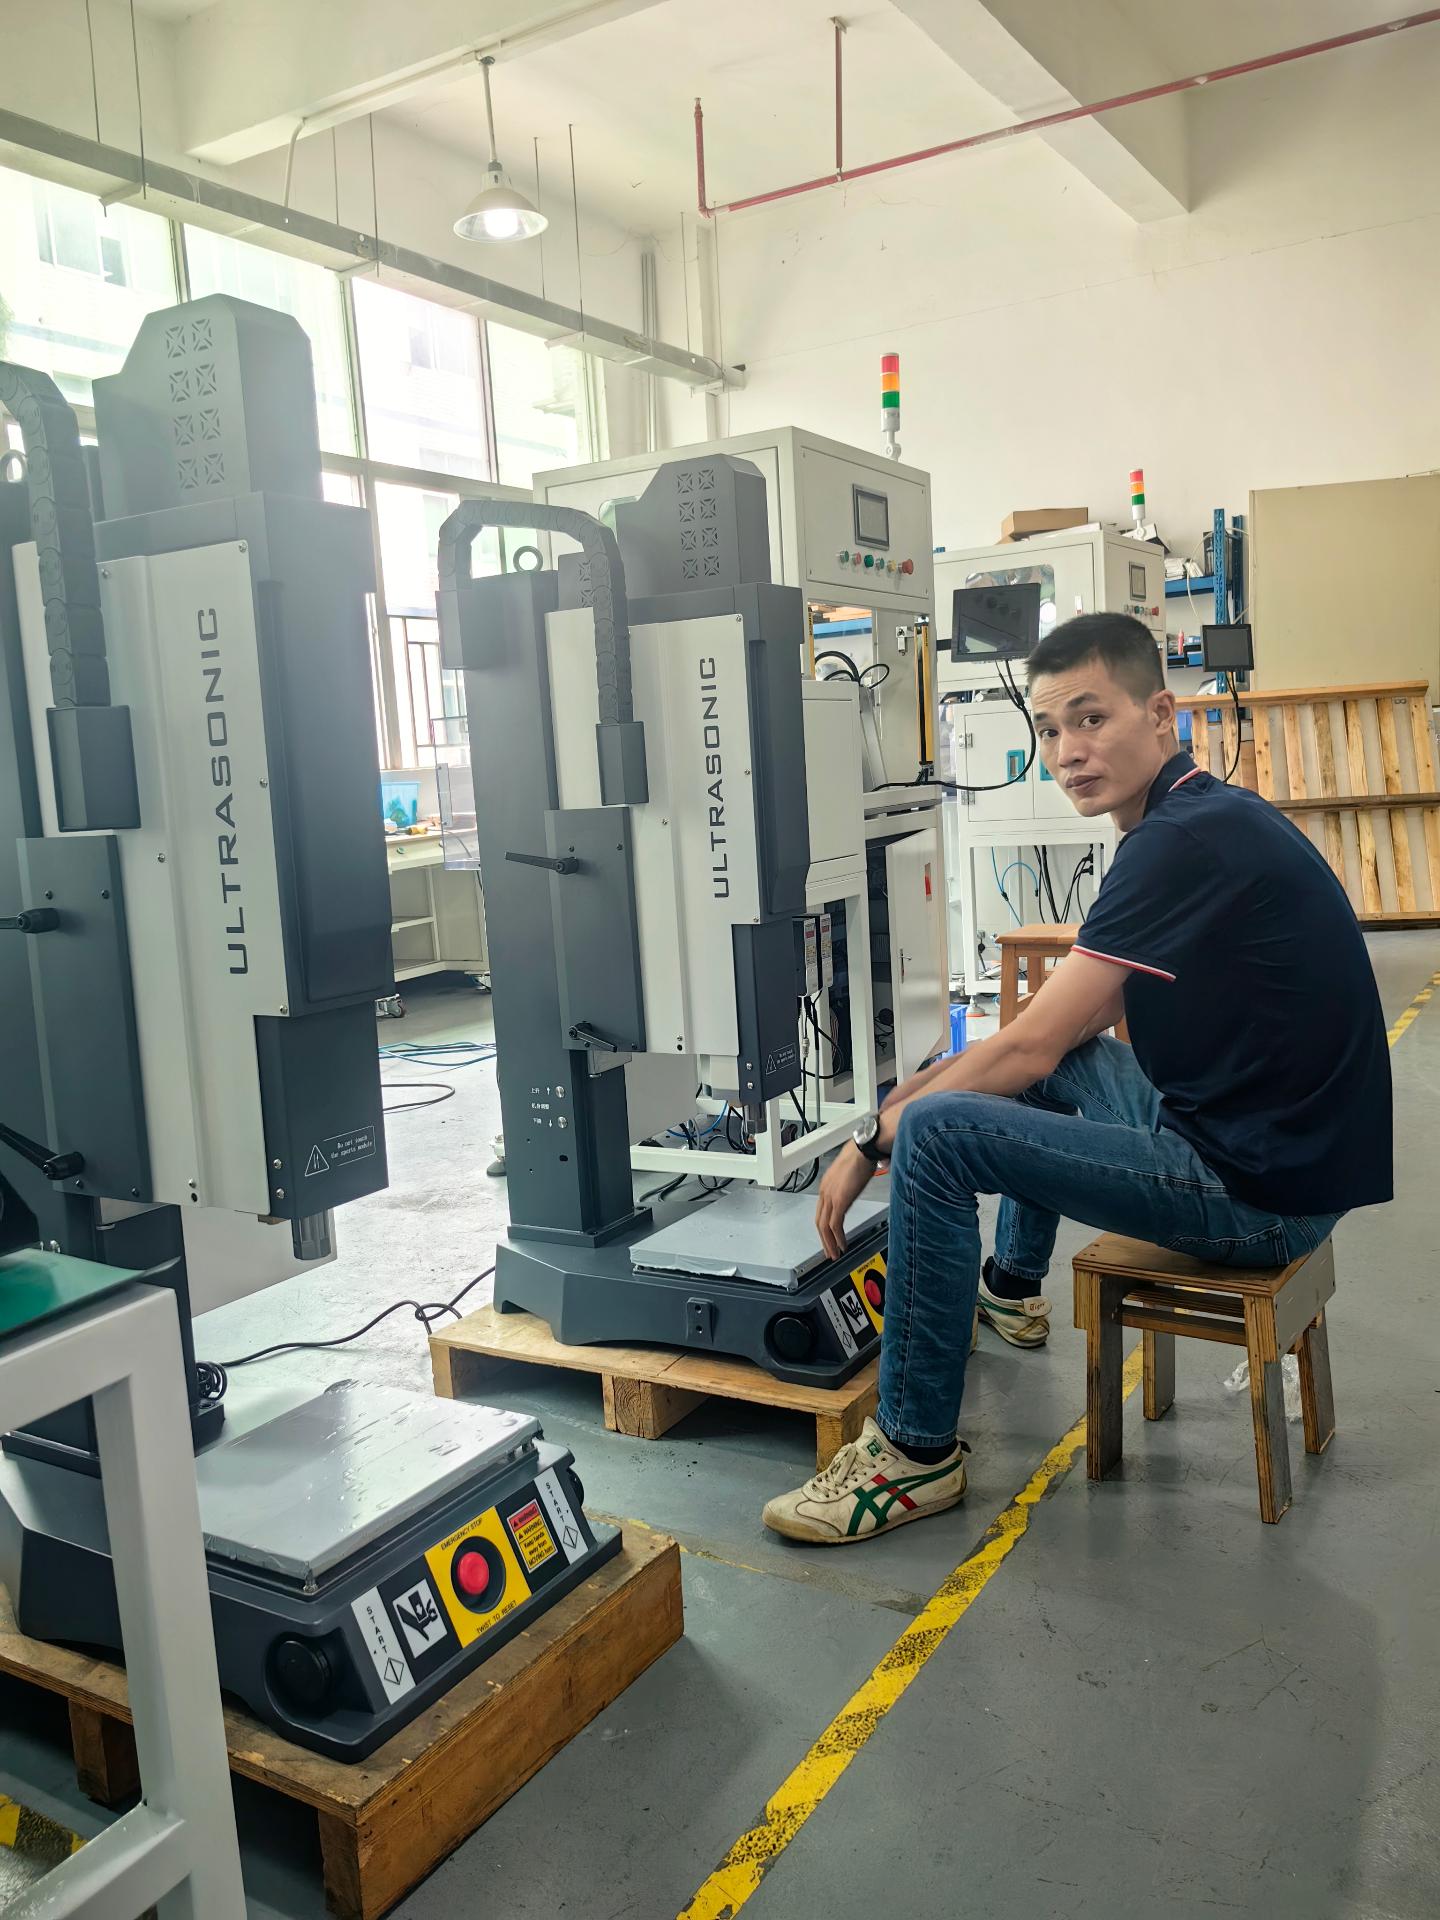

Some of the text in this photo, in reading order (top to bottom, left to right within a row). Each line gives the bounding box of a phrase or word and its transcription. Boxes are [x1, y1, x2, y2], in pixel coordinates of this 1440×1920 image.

[198, 607, 248, 974] ULTRASONIC
[700, 657, 730, 898] ULTRASONIC
[545, 1482, 565, 1523] START
[441, 1518, 483, 1551] EMERGENCY STOP
[366, 1606, 388, 1654] START
[477, 1600, 517, 1634] TWIST TO RESET
